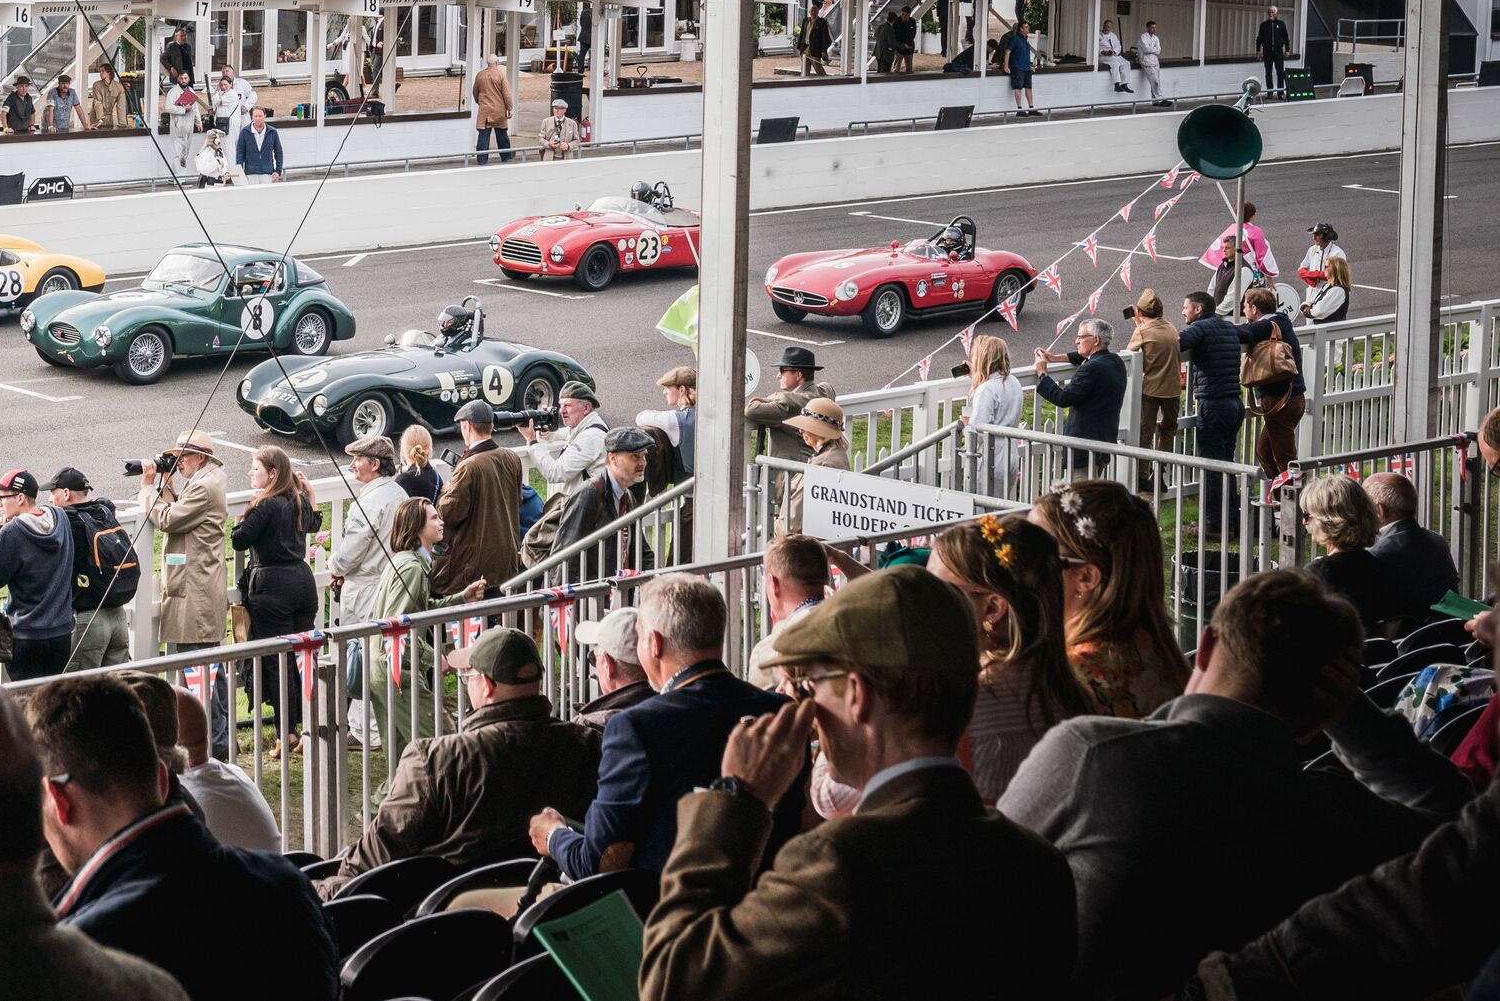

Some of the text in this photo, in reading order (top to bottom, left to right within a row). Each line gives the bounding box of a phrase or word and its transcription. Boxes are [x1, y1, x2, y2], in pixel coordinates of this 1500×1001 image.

[16, 7, 28, 23] 16
[196, 1, 208, 17] 17
[38, 181, 65, 195] DHG
[639, 236, 658, 260] 23
[252, 304, 262, 330] 8
[489, 369, 502, 395] 4
[811, 484, 907, 517] GRANDSTAND
[832, 510, 897, 533] HOLDERS
